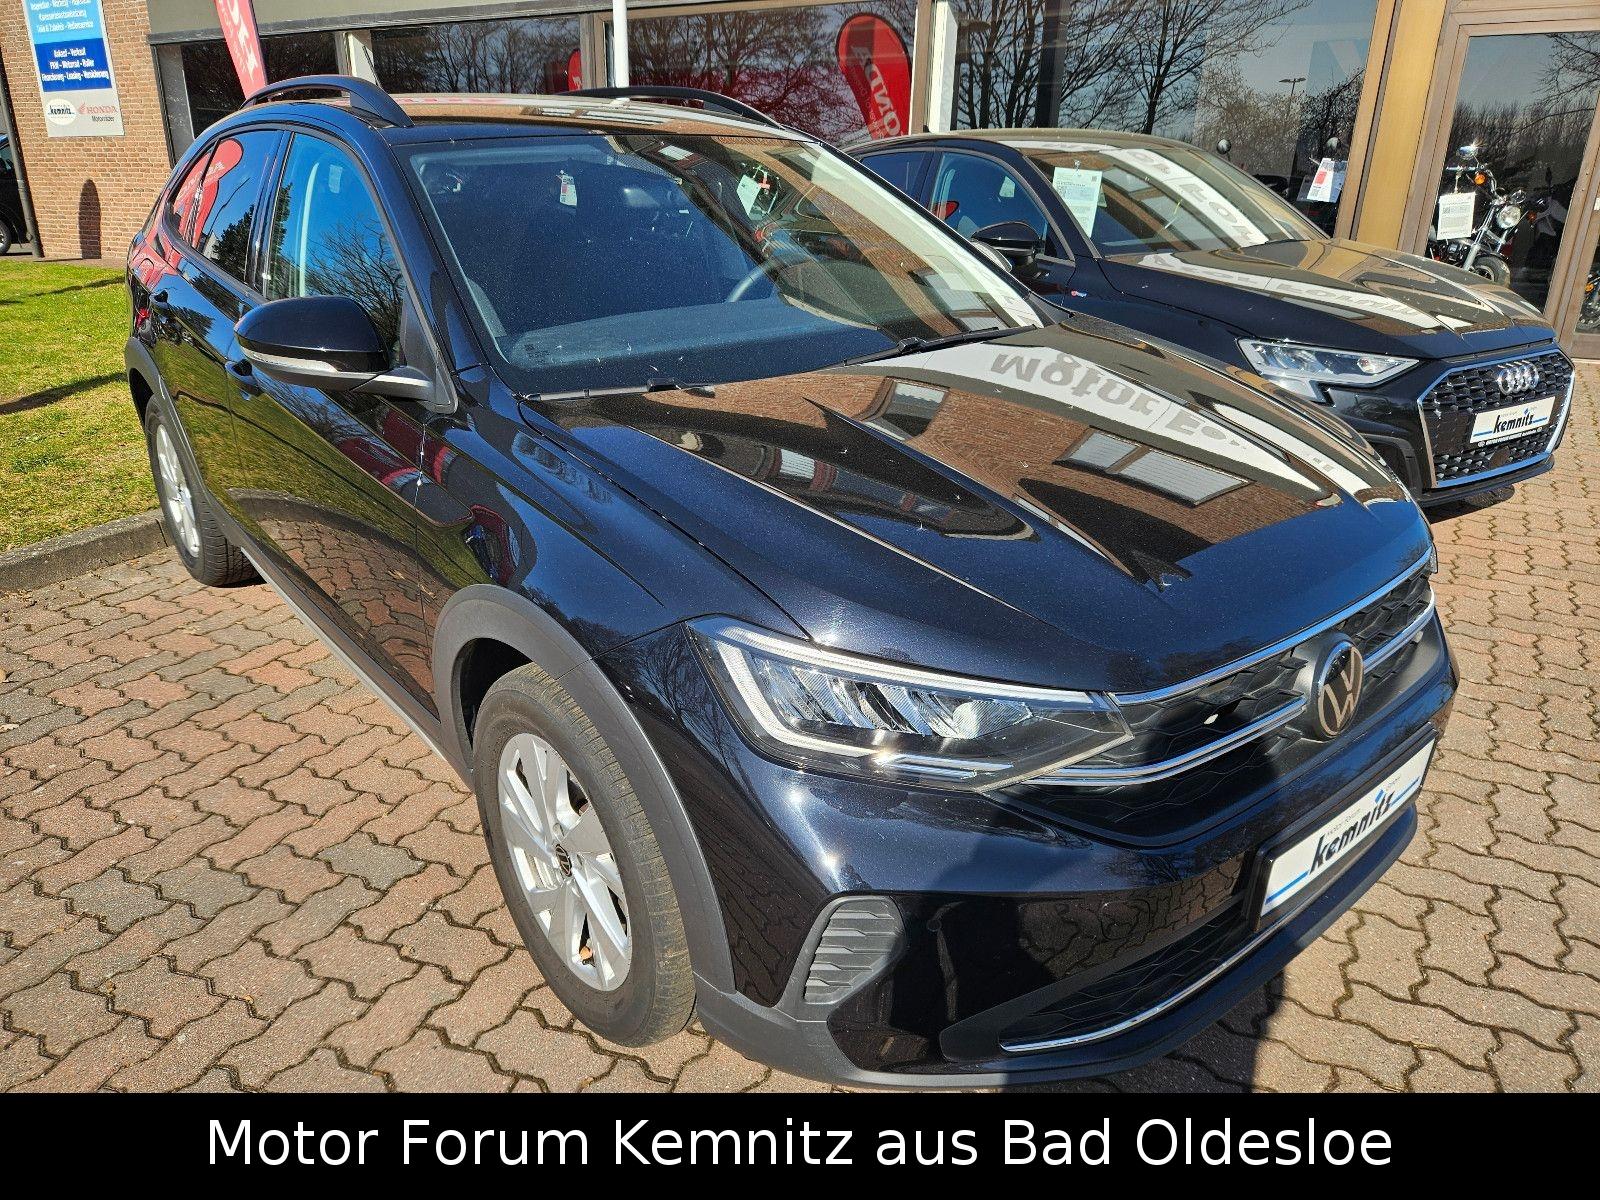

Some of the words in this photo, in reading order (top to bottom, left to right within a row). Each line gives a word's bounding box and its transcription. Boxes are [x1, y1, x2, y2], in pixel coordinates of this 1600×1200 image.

[86, 105, 118, 114] HONDA
[1493, 412, 1535, 434] kemnitz
[1308, 791, 1396, 875] kemnitz
